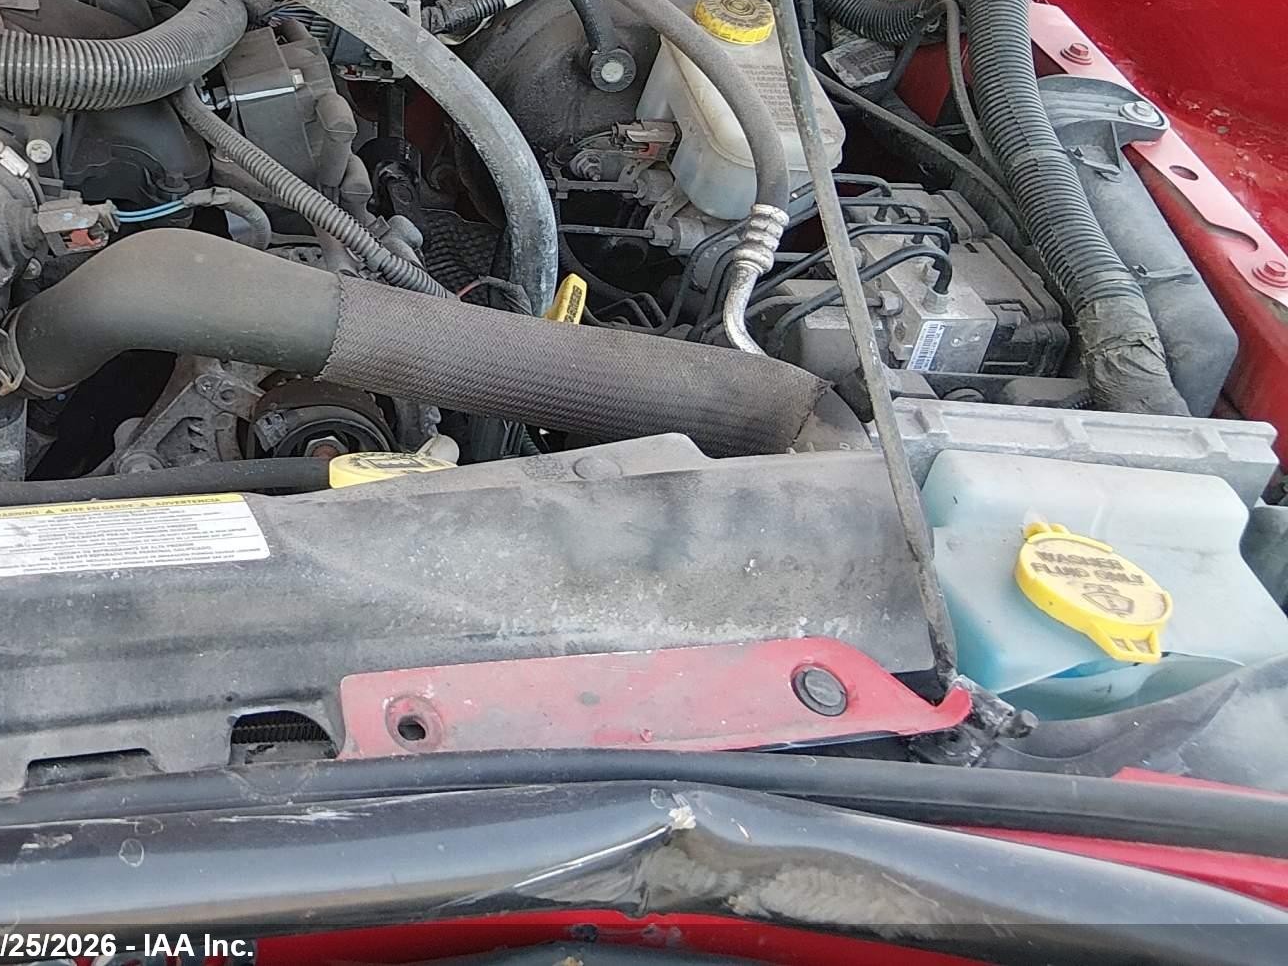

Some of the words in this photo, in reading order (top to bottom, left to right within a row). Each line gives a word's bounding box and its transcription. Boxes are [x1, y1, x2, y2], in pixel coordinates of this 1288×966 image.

[1035, 550, 1125, 570] WASHER
[1030, 562, 1090, 578] FLUID
[1093, 569, 1145, 586] ONLY
